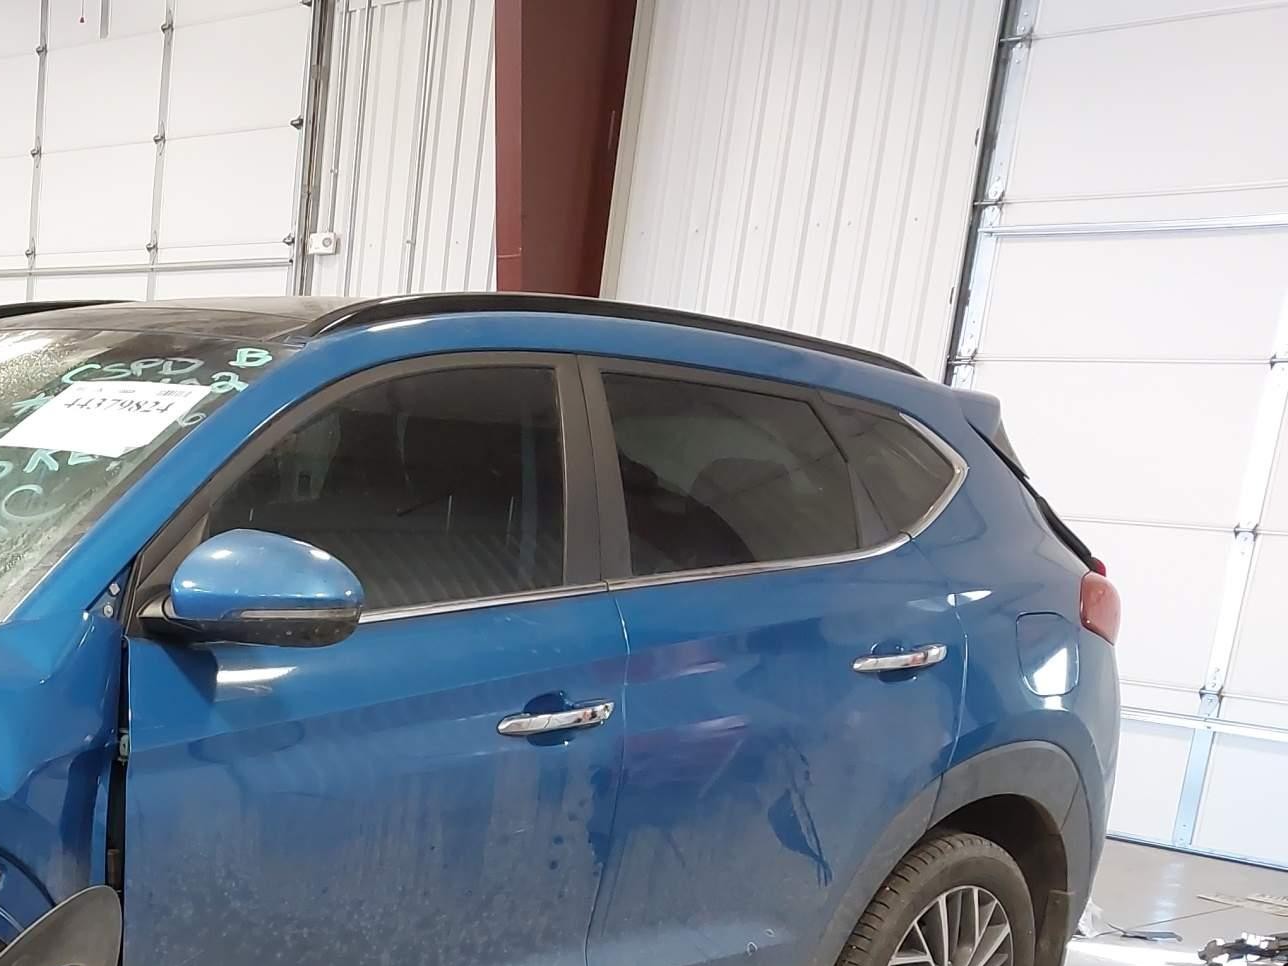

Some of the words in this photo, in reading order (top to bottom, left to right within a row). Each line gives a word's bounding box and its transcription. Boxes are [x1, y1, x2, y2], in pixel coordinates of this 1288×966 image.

[61, 356, 205, 383] CSPD
[228, 347, 273, 369] B
[63, 397, 176, 415] 44379824
